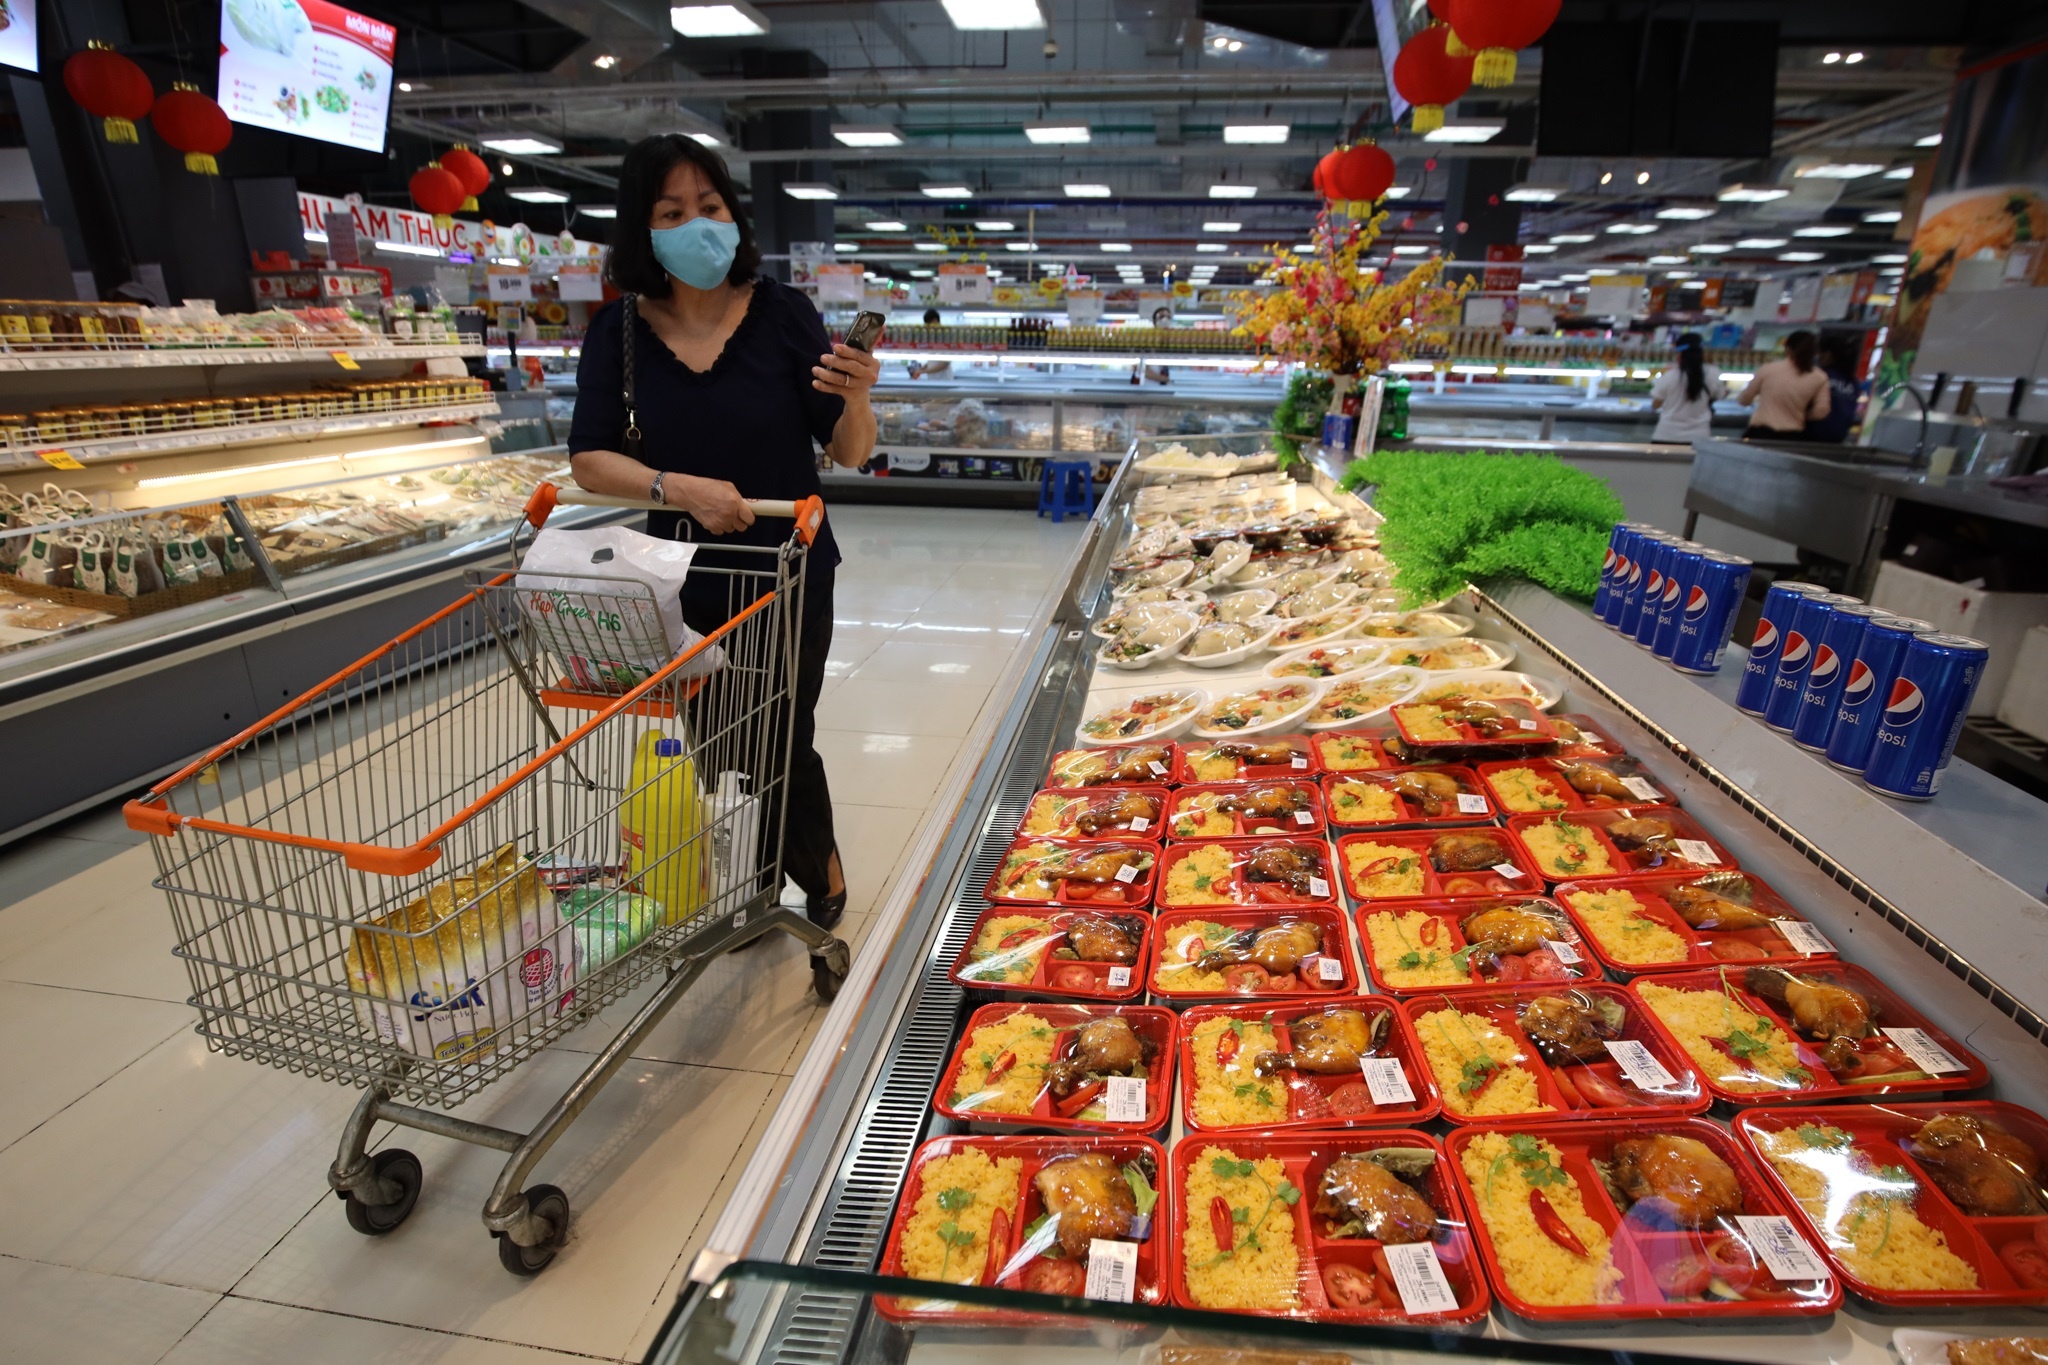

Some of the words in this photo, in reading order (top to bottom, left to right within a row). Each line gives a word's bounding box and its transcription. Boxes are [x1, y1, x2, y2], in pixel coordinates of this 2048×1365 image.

[1747, 661, 1766, 675] epsi
[1774, 675, 1797, 691] epsi
[1803, 691, 1825, 707] epsi
[1838, 708, 1859, 725] epsi
[1877, 727, 1906, 748] epsi
